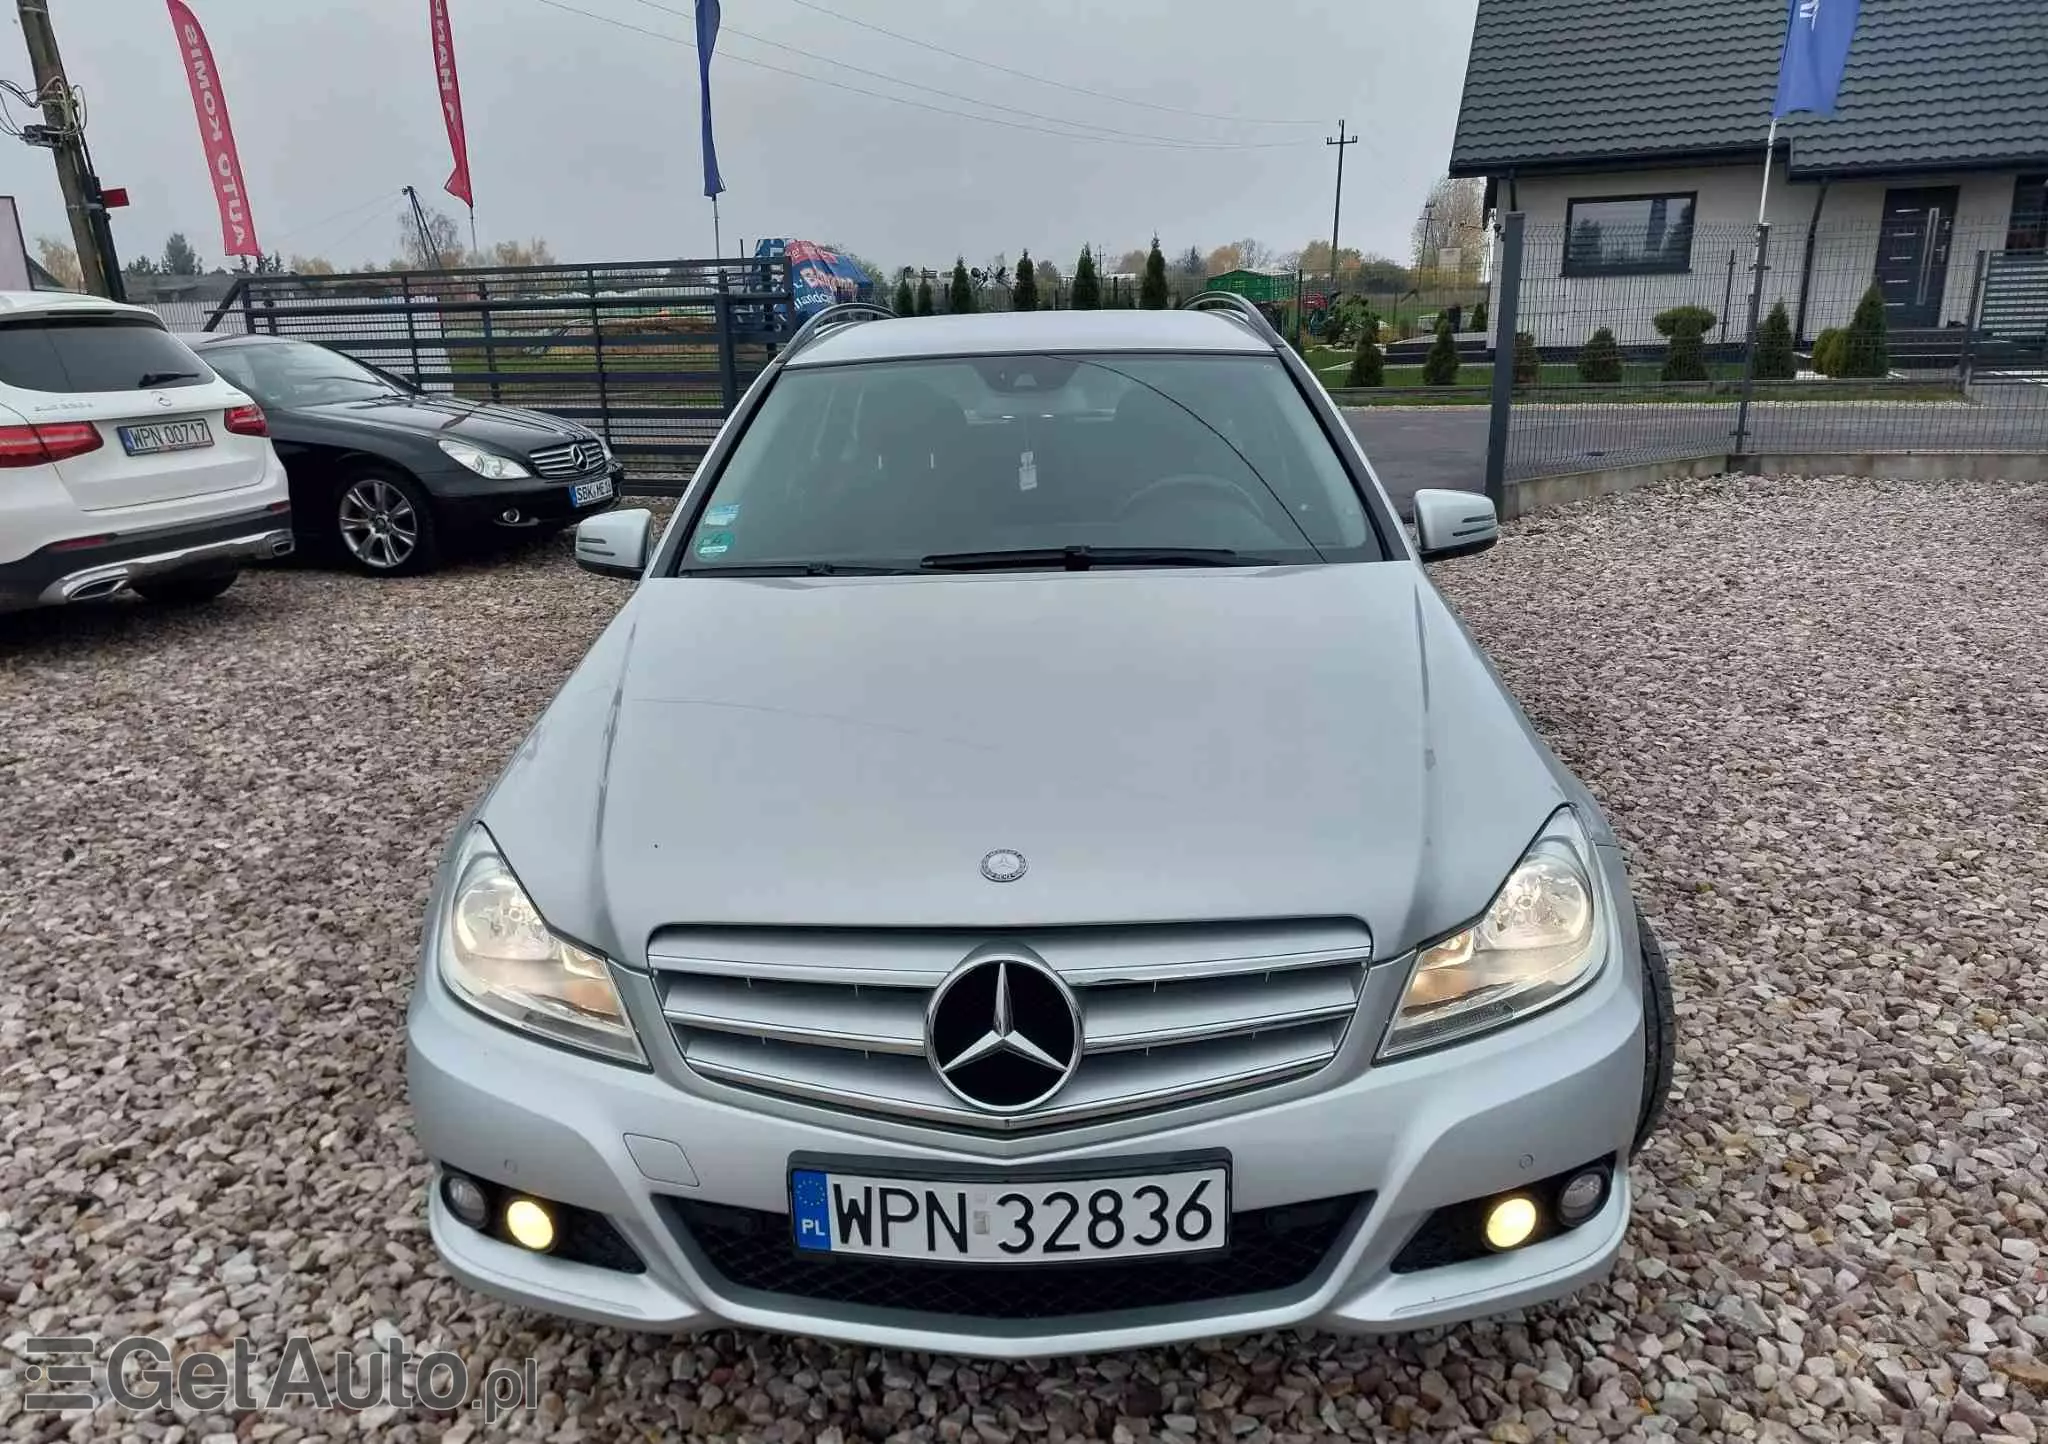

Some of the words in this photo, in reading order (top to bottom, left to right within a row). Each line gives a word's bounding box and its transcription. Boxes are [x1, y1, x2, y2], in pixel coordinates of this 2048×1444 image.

[130, 427, 163, 448] WPN
[164, 423, 205, 444] 00717
[802, 1218, 826, 1236] PL
[833, 1183, 968, 1254] WPN
[997, 1179, 1213, 1254] 32836
